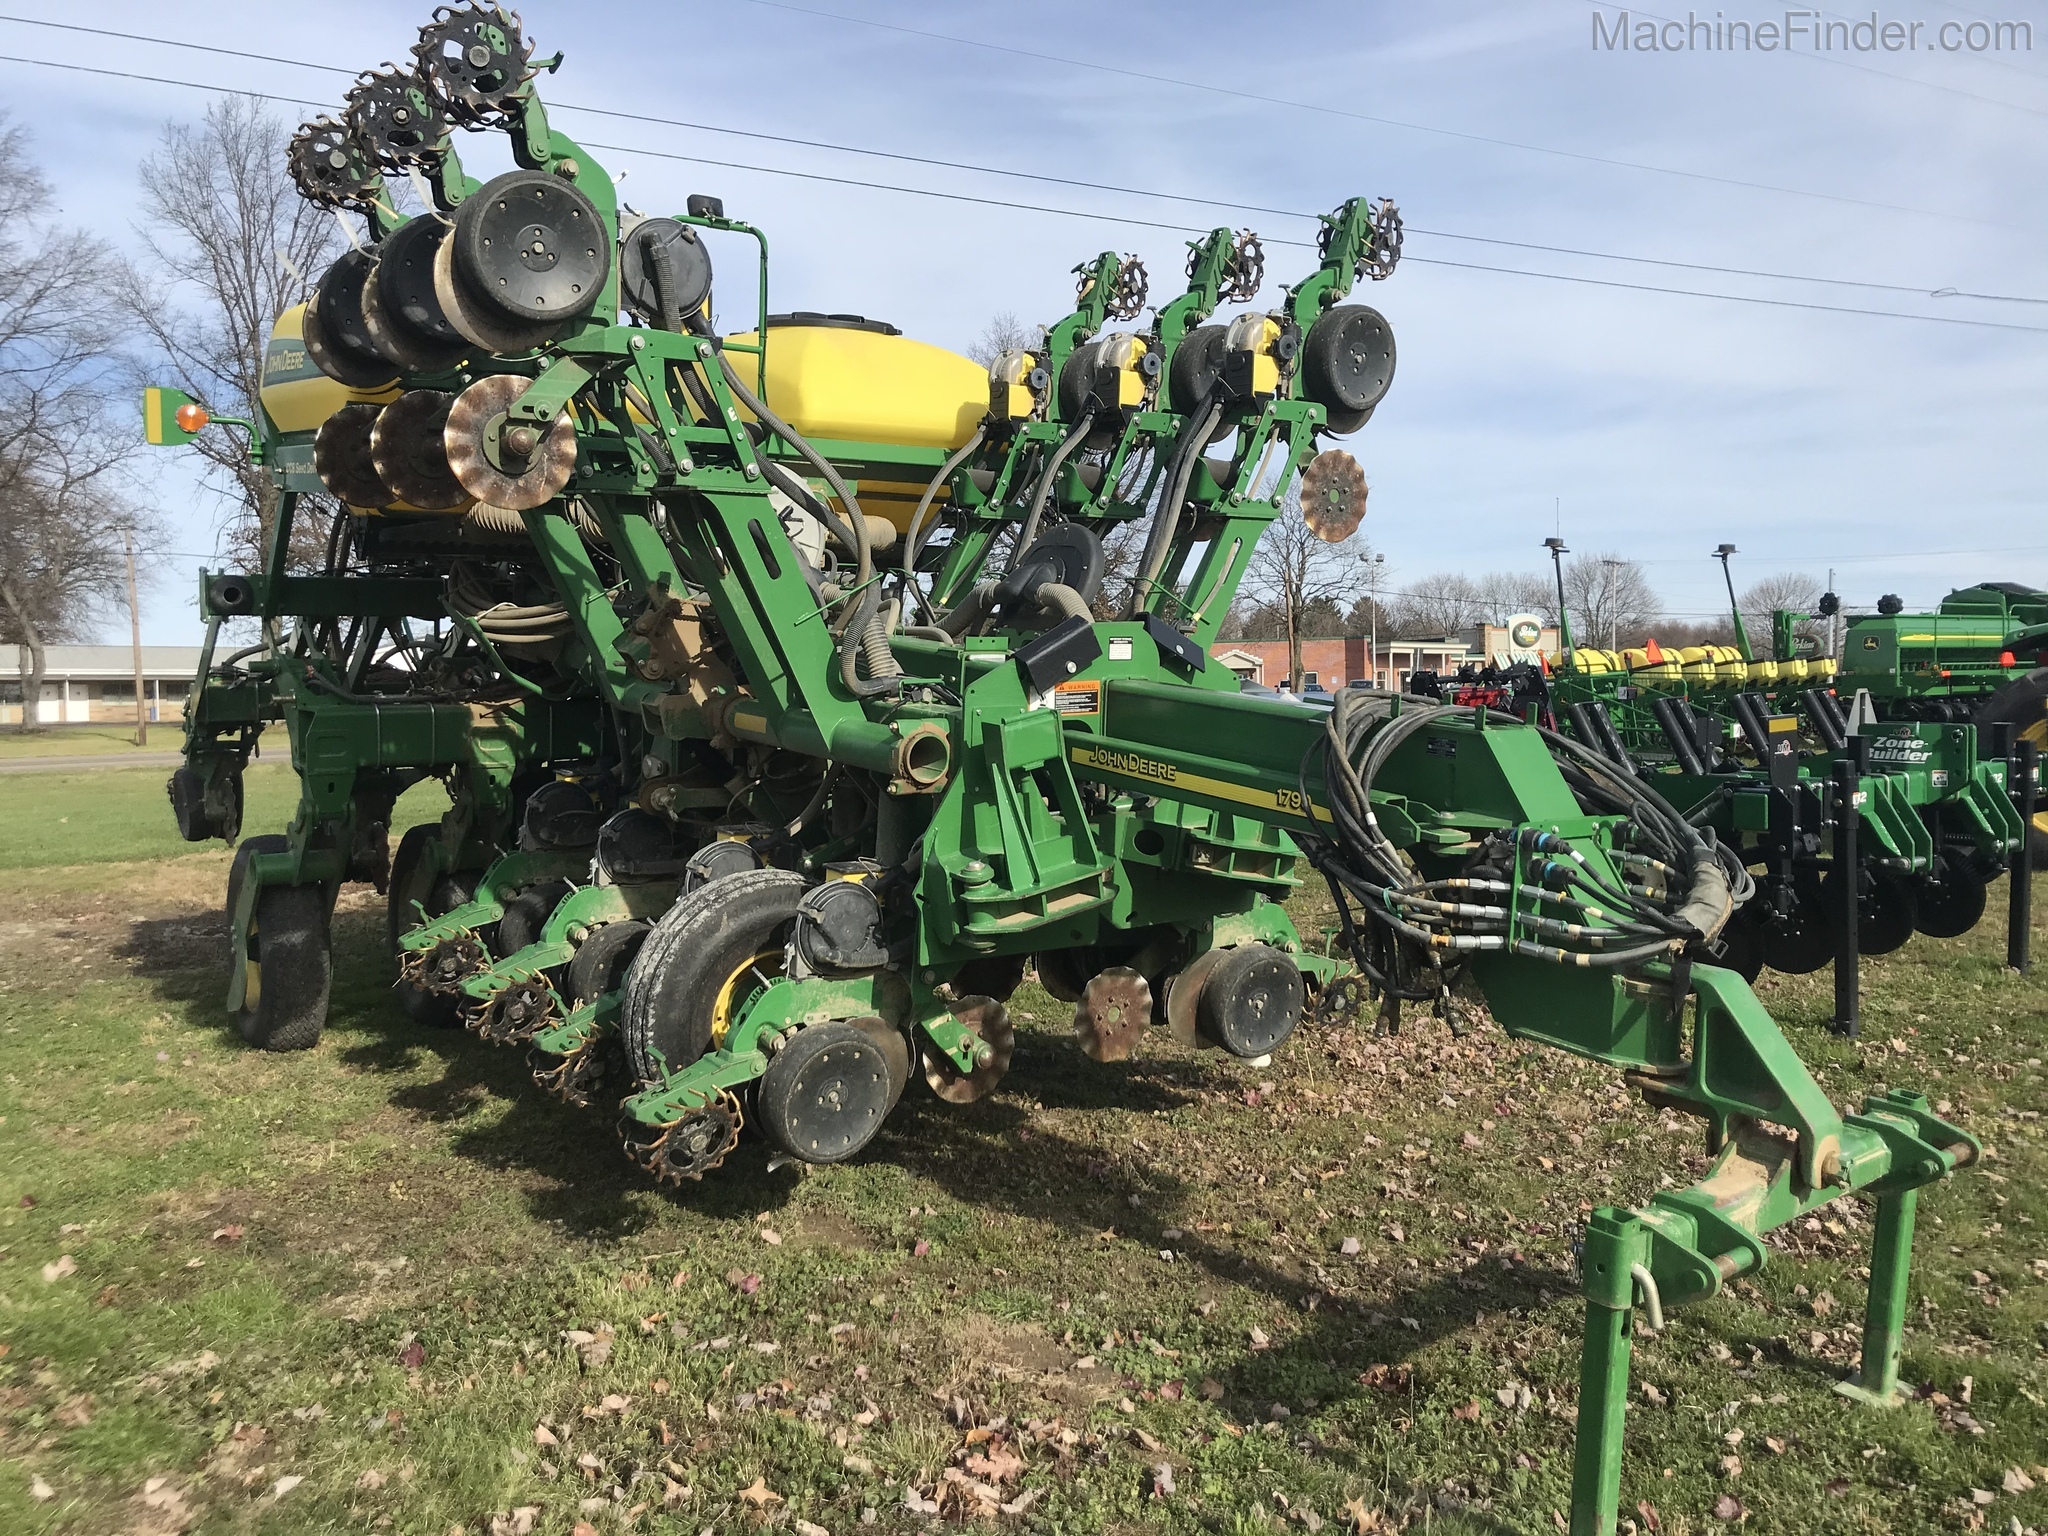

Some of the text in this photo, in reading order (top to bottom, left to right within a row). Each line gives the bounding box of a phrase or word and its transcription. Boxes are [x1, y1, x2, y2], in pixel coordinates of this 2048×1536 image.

[281, 349, 305, 370] DEERE
[1873, 736, 1929, 749] Zone-
[1089, 745, 1177, 782] JOHN DEERE
